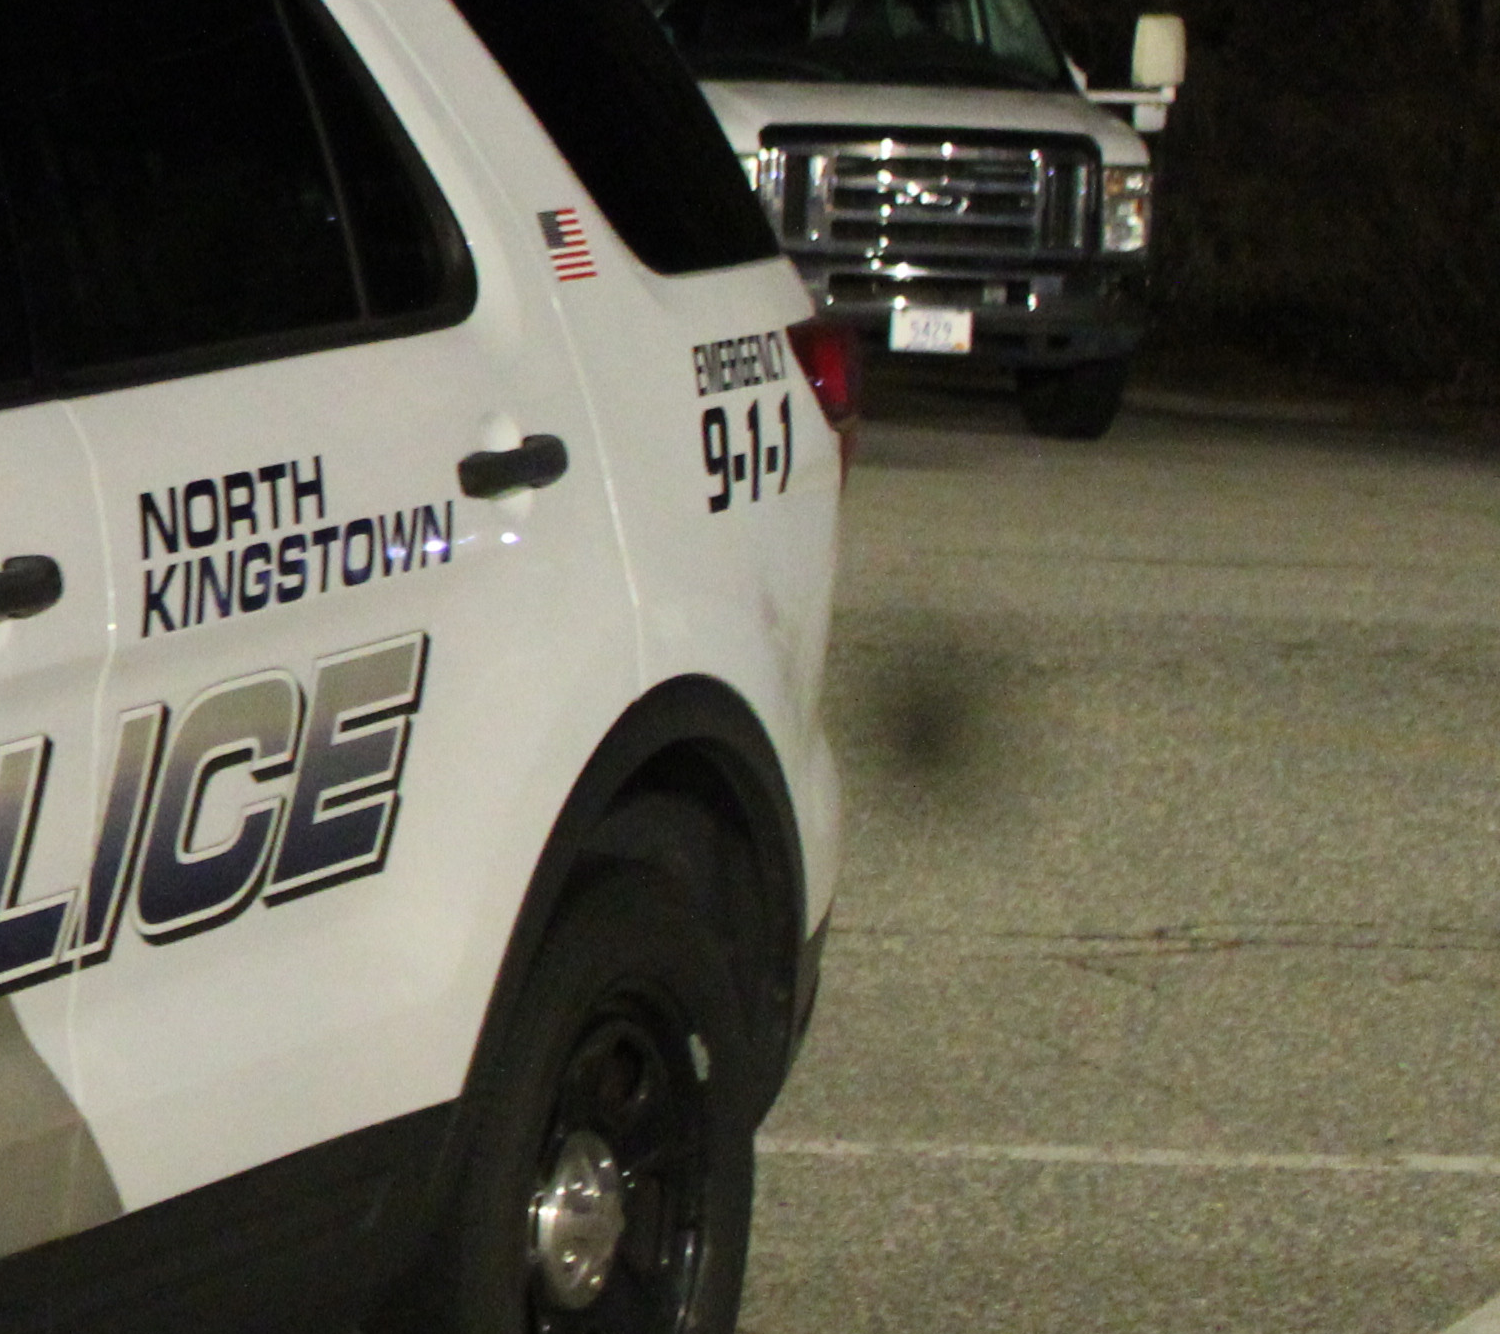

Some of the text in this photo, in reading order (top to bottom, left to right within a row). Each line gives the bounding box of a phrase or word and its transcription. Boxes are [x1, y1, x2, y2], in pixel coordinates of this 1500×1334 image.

[693, 330, 786, 397] EMERGENCY
[139, 454, 325, 560] NORTH
[702, 391, 792, 513] 9-1-1
[141, 500, 453, 638] KINGSTOWN
